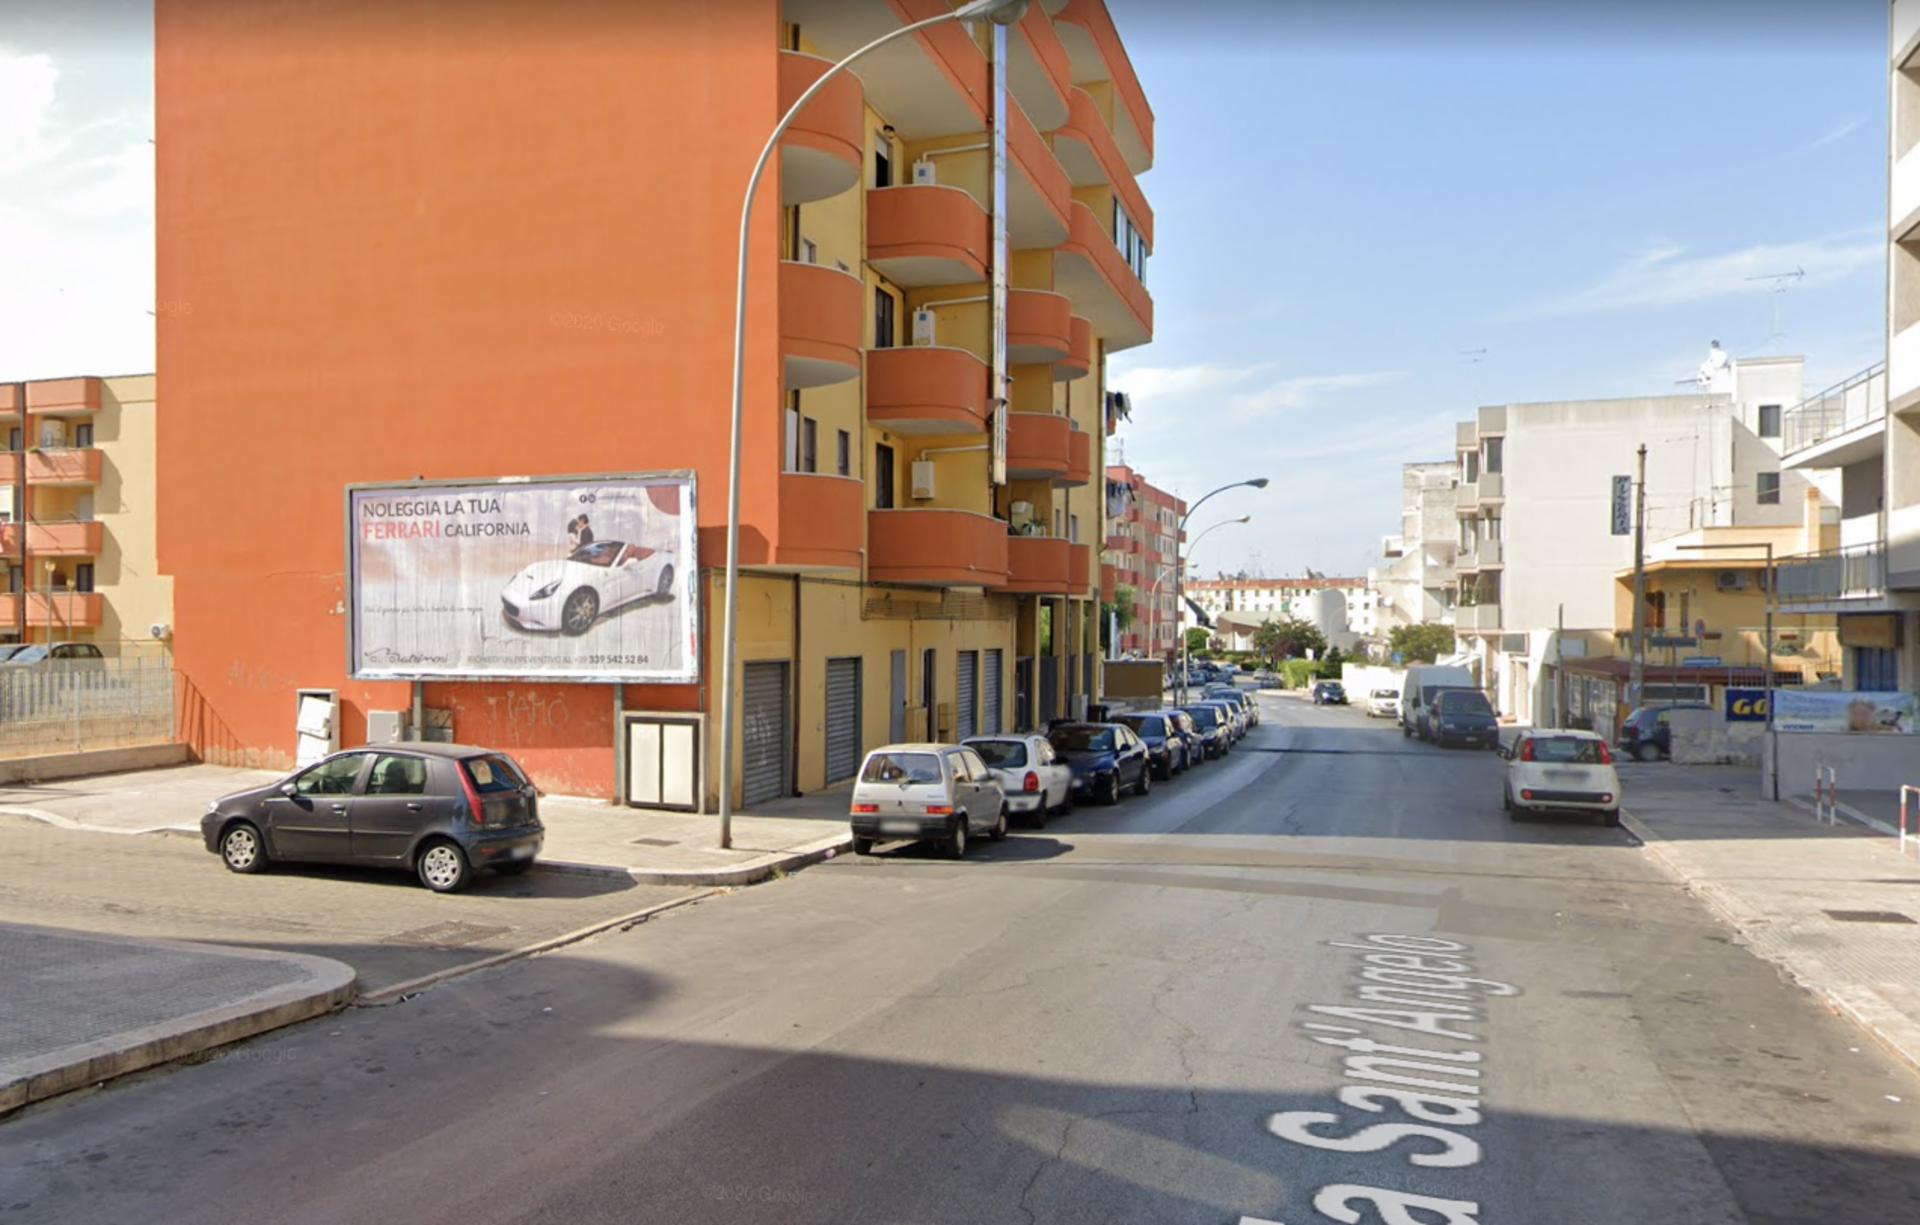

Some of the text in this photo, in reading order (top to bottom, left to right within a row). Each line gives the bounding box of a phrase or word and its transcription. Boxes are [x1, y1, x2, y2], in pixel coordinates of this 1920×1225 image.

[363, 498, 500, 517] NOLEGGIA LA TUA
[362, 521, 531, 539] FERRARI CALIFORNIA
[589, 655, 605, 664] 339
[607, 655, 622, 664] 542
[625, 655, 635, 664] 52
